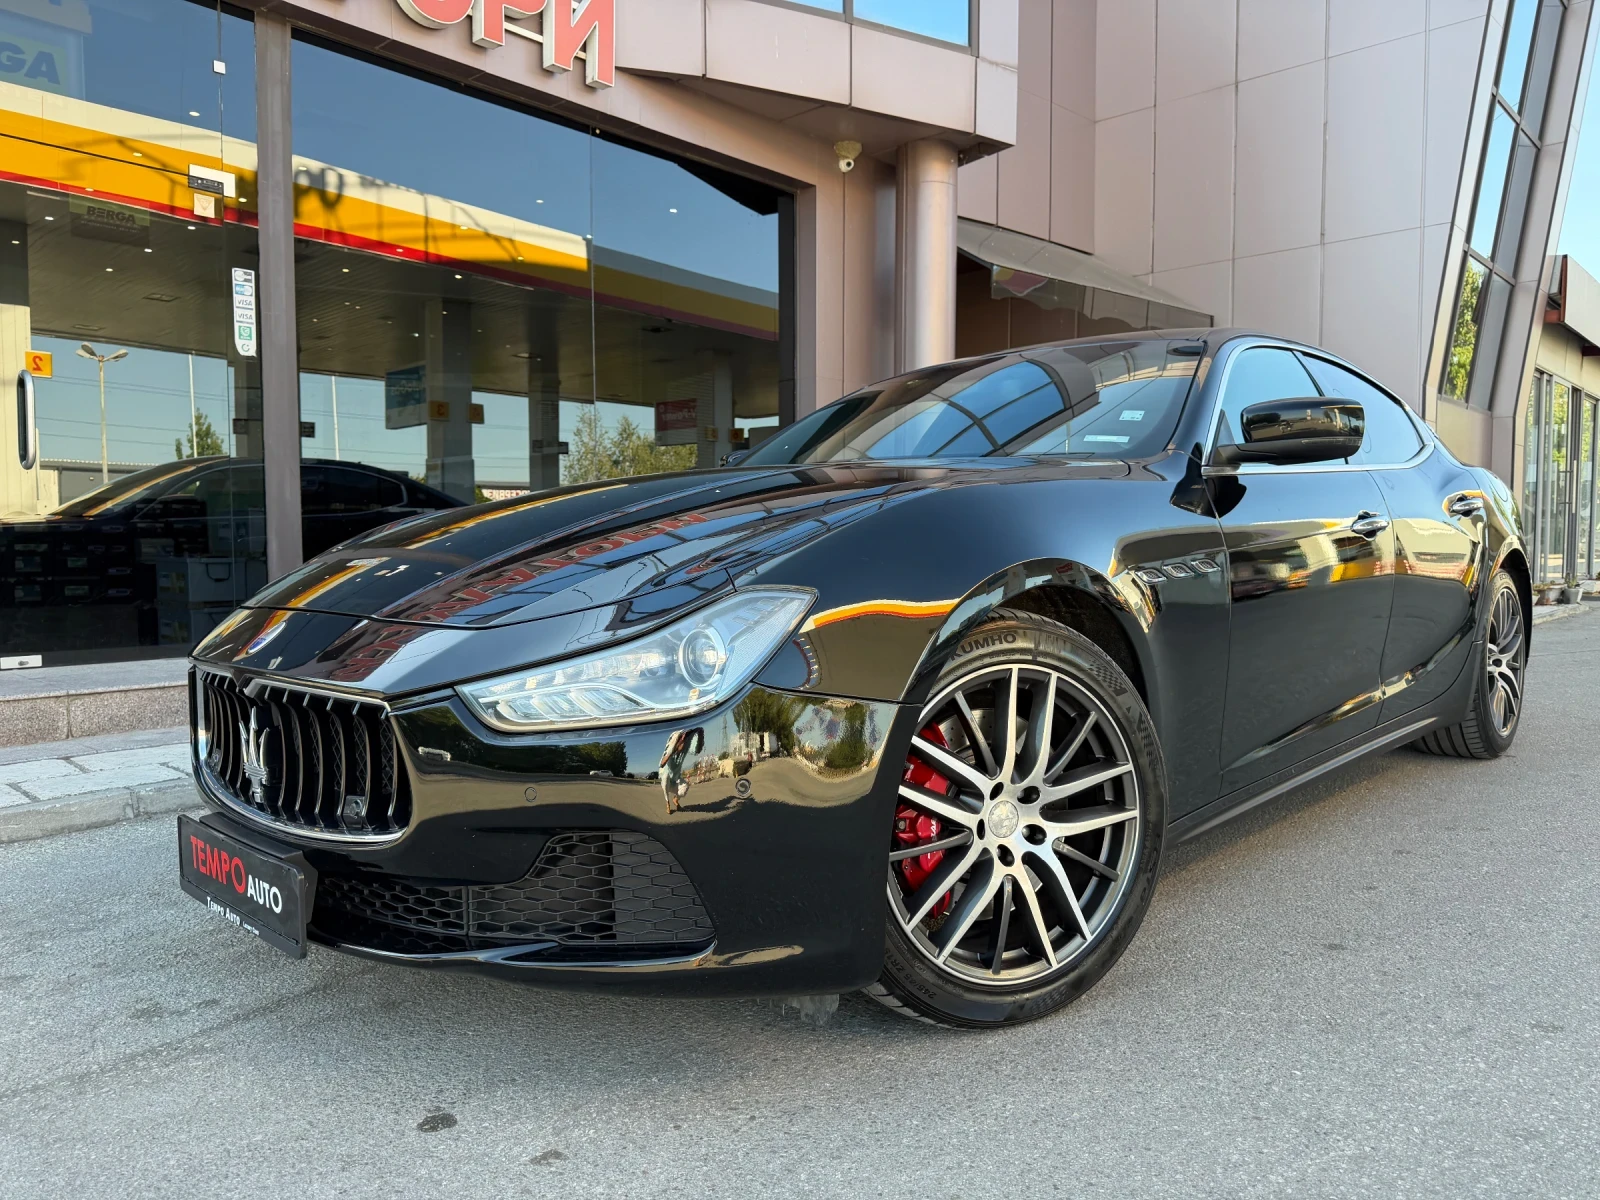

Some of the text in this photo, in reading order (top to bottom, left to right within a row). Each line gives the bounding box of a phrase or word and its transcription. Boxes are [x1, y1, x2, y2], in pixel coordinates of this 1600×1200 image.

[87, 206, 136, 225] BERGA
[237, 299, 253, 307] VISA
[190, 835, 282, 914] TEMPO AUTO
